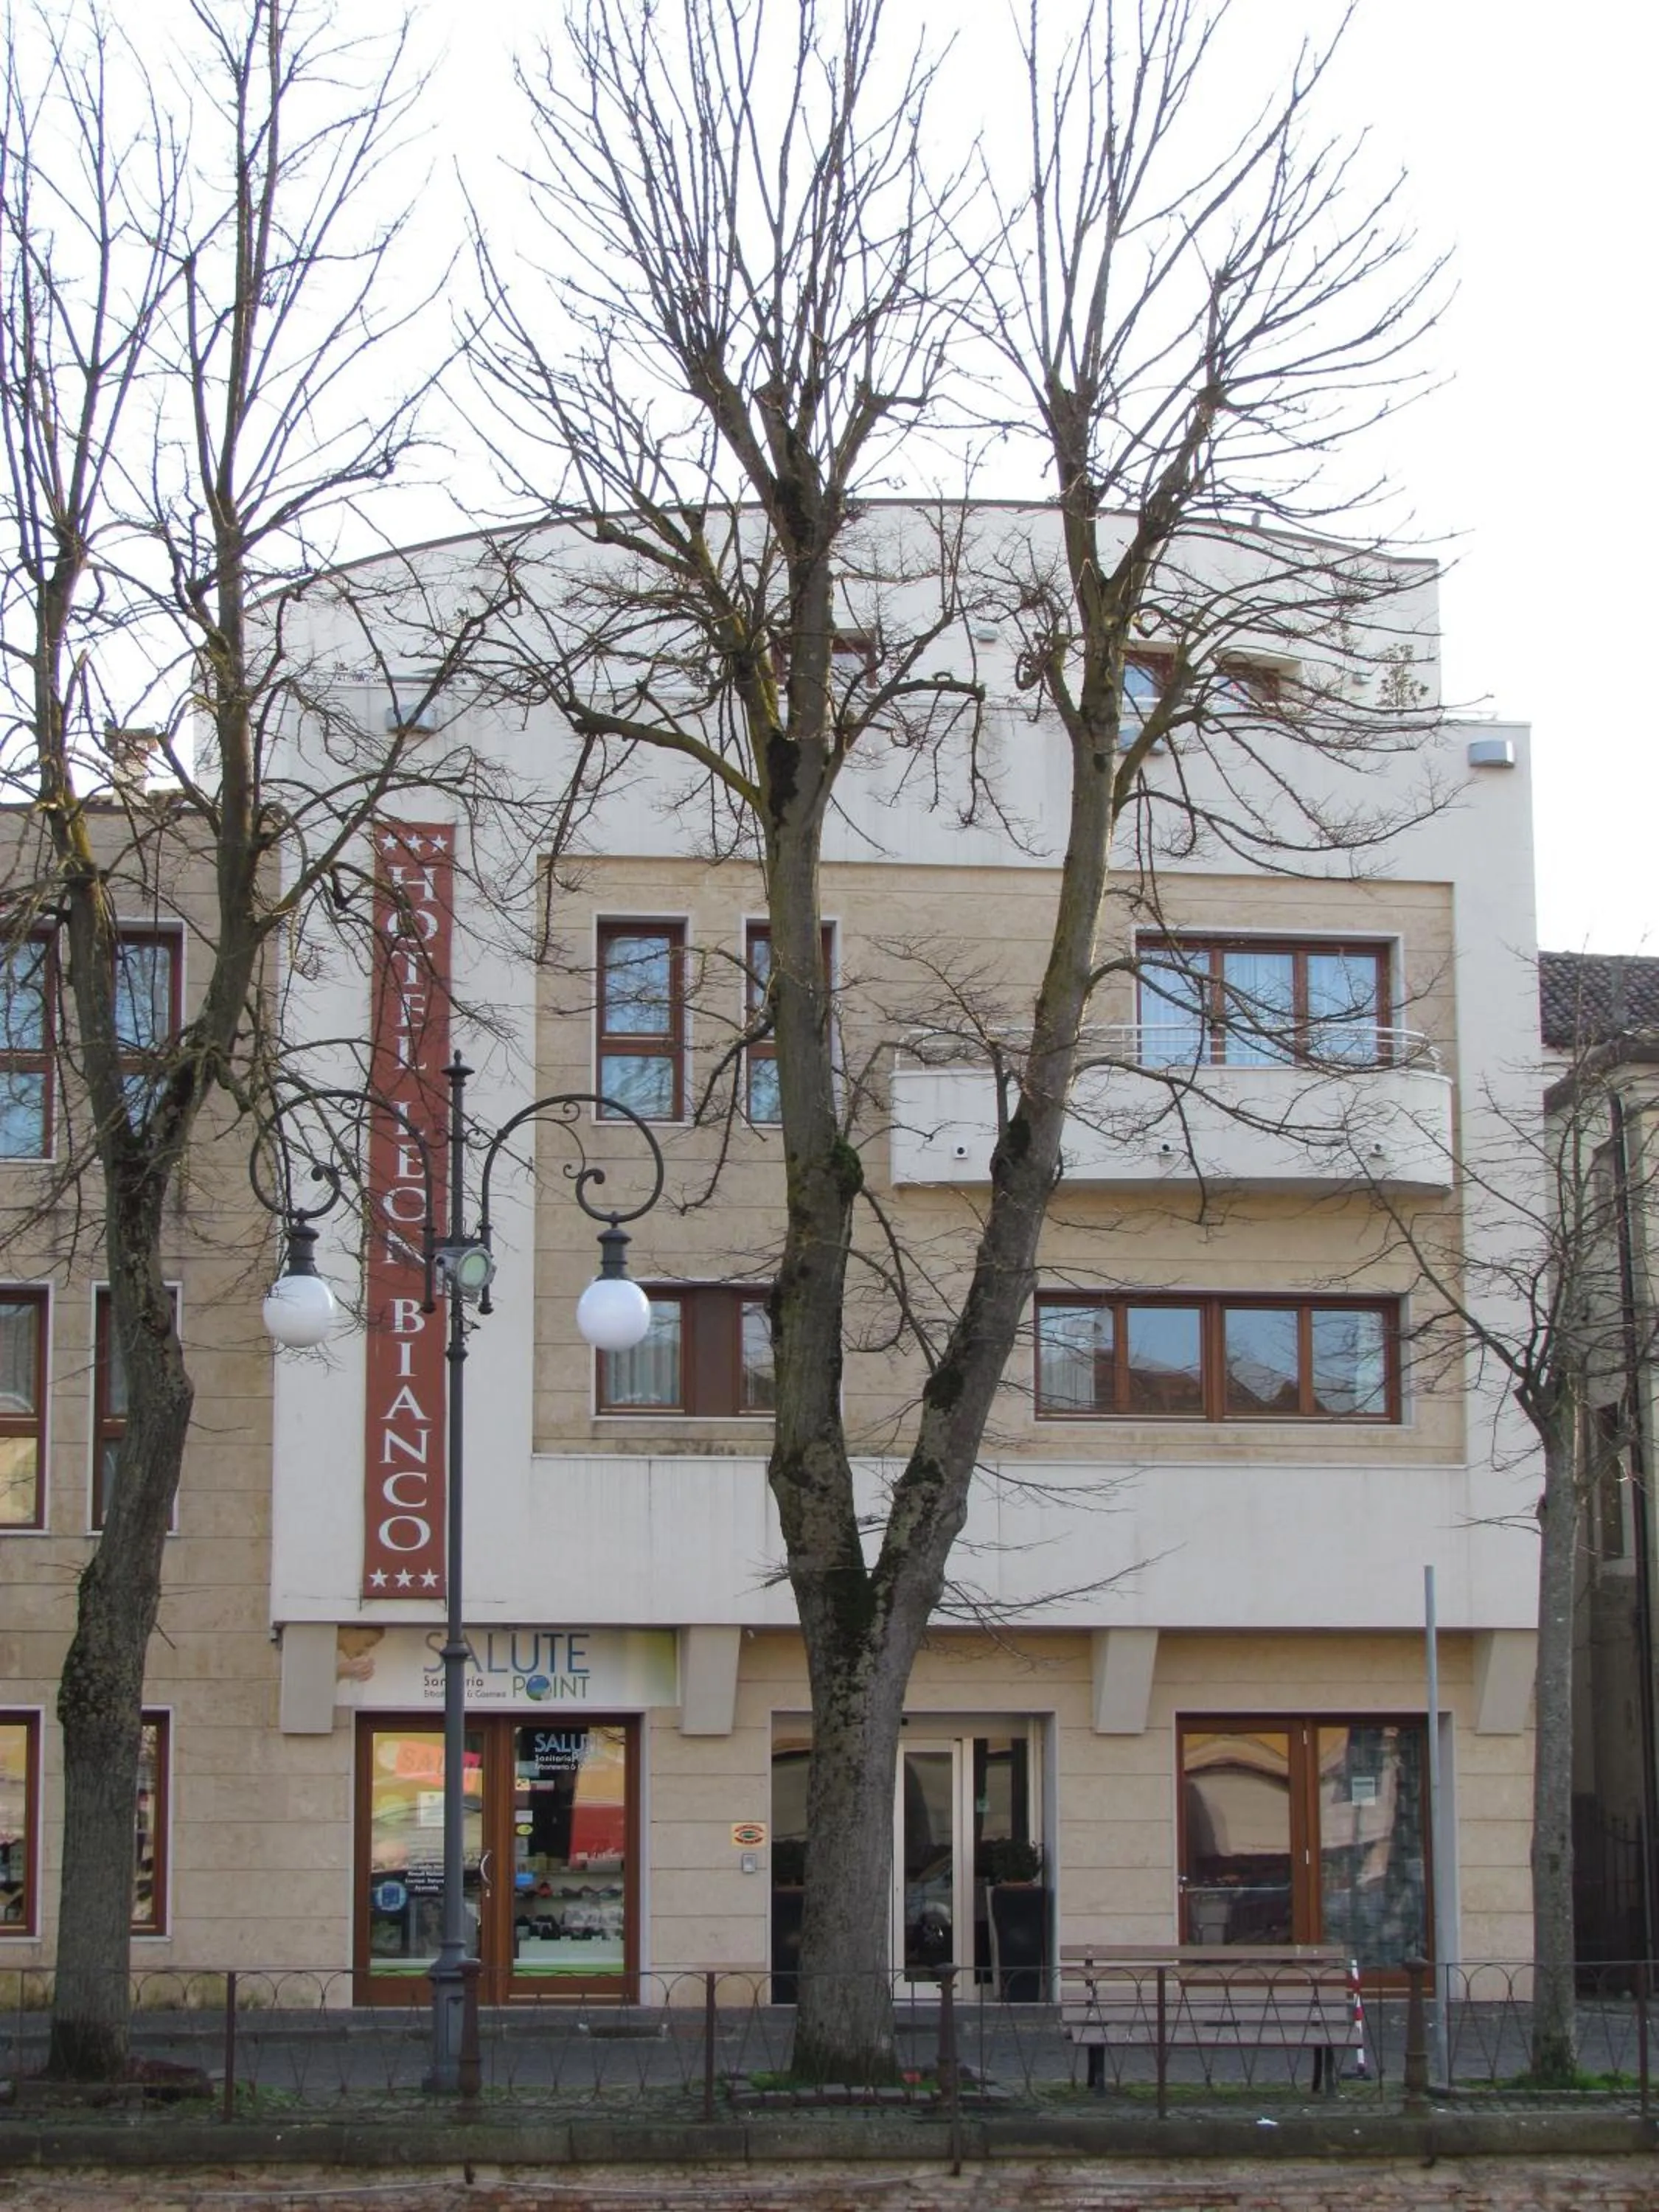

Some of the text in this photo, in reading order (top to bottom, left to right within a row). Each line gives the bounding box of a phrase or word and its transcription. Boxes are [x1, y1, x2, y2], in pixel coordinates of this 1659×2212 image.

[386, 866, 439, 1071] HOTEL
[378, 1298, 432, 1551] BIANCO
[423, 1632, 589, 1674] SALUTE
[424, 1674, 484, 1687] Sanria
